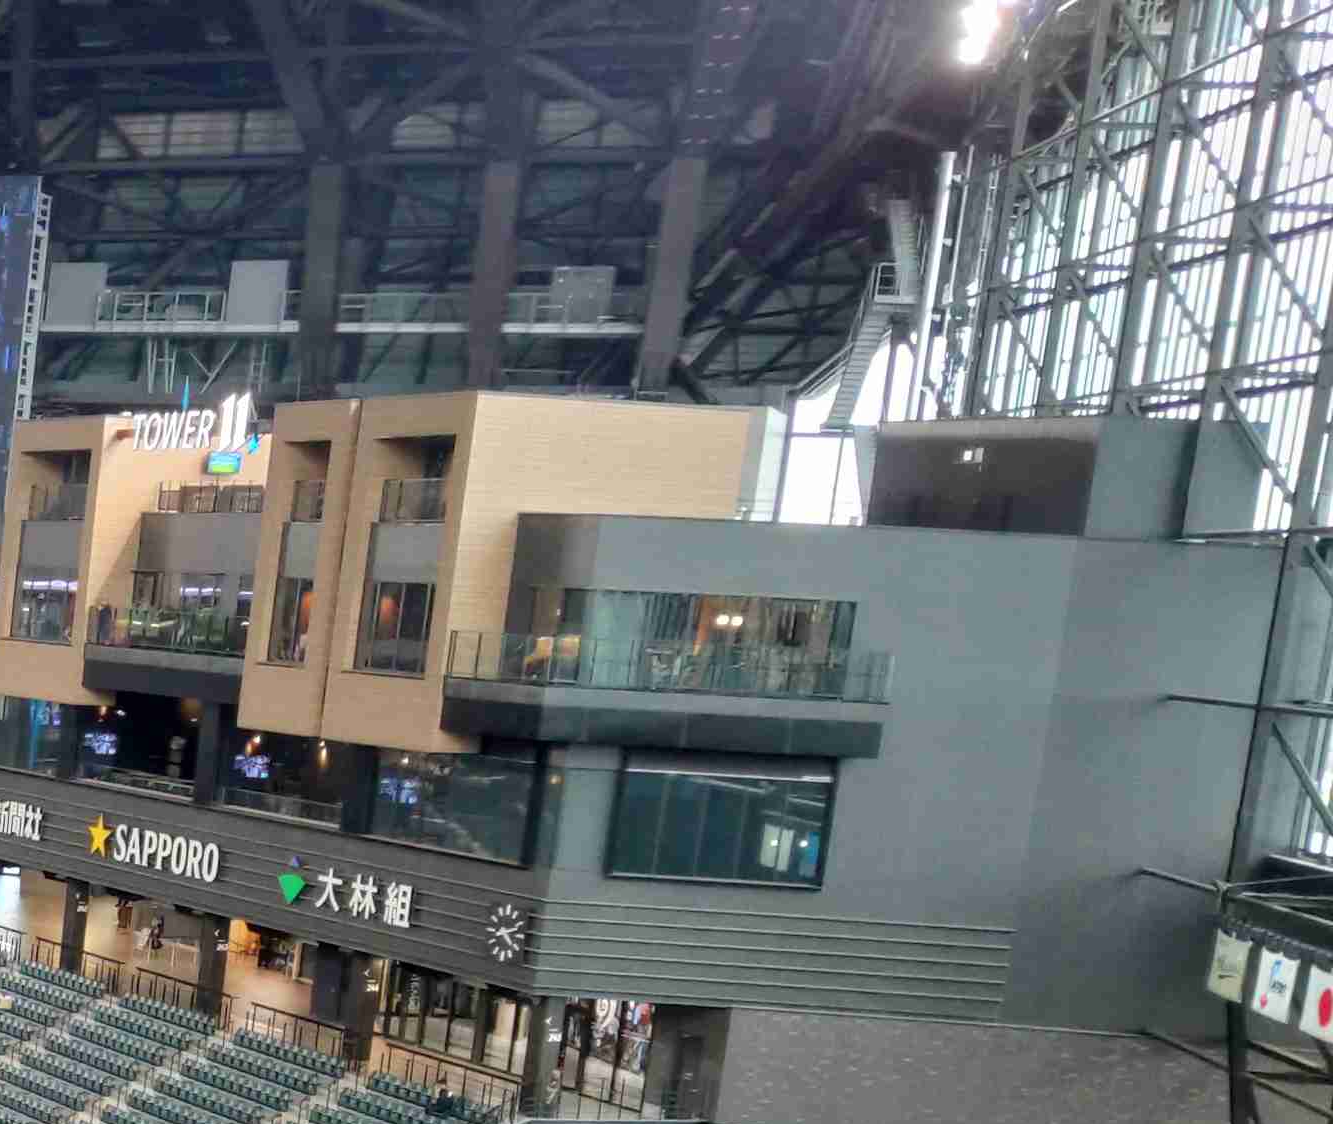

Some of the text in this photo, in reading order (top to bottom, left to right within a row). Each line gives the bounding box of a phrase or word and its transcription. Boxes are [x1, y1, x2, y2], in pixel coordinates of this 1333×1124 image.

[132, 391, 252, 452] TOWER 11
[111, 823, 220, 884] SAPPORO
[314, 868, 413, 928] 大林組
